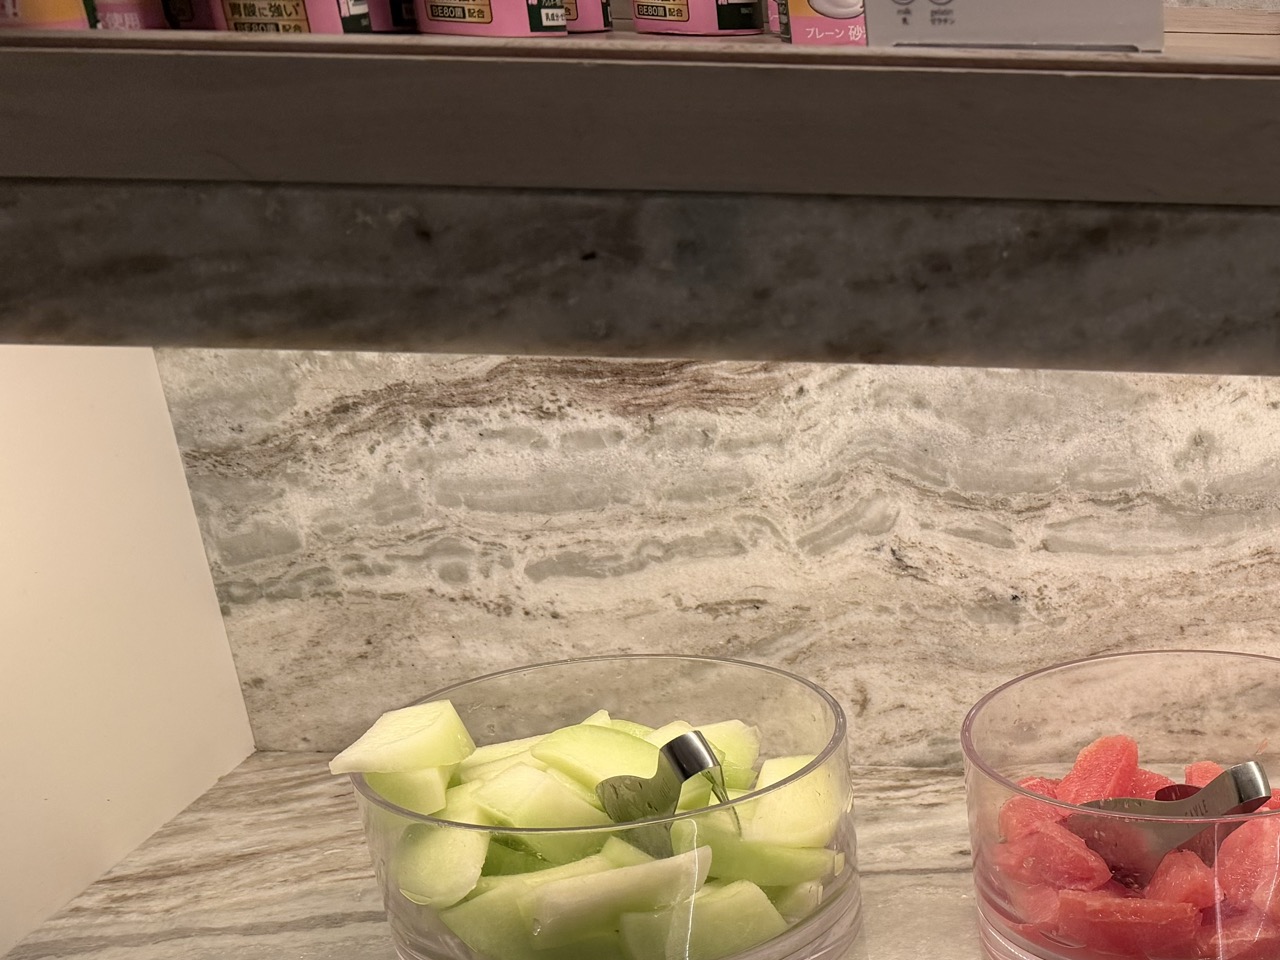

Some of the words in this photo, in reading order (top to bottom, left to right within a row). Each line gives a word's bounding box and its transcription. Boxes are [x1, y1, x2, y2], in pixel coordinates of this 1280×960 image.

[805, 27, 845, 39] プレーン
[848, 25, 867, 41] 砂
